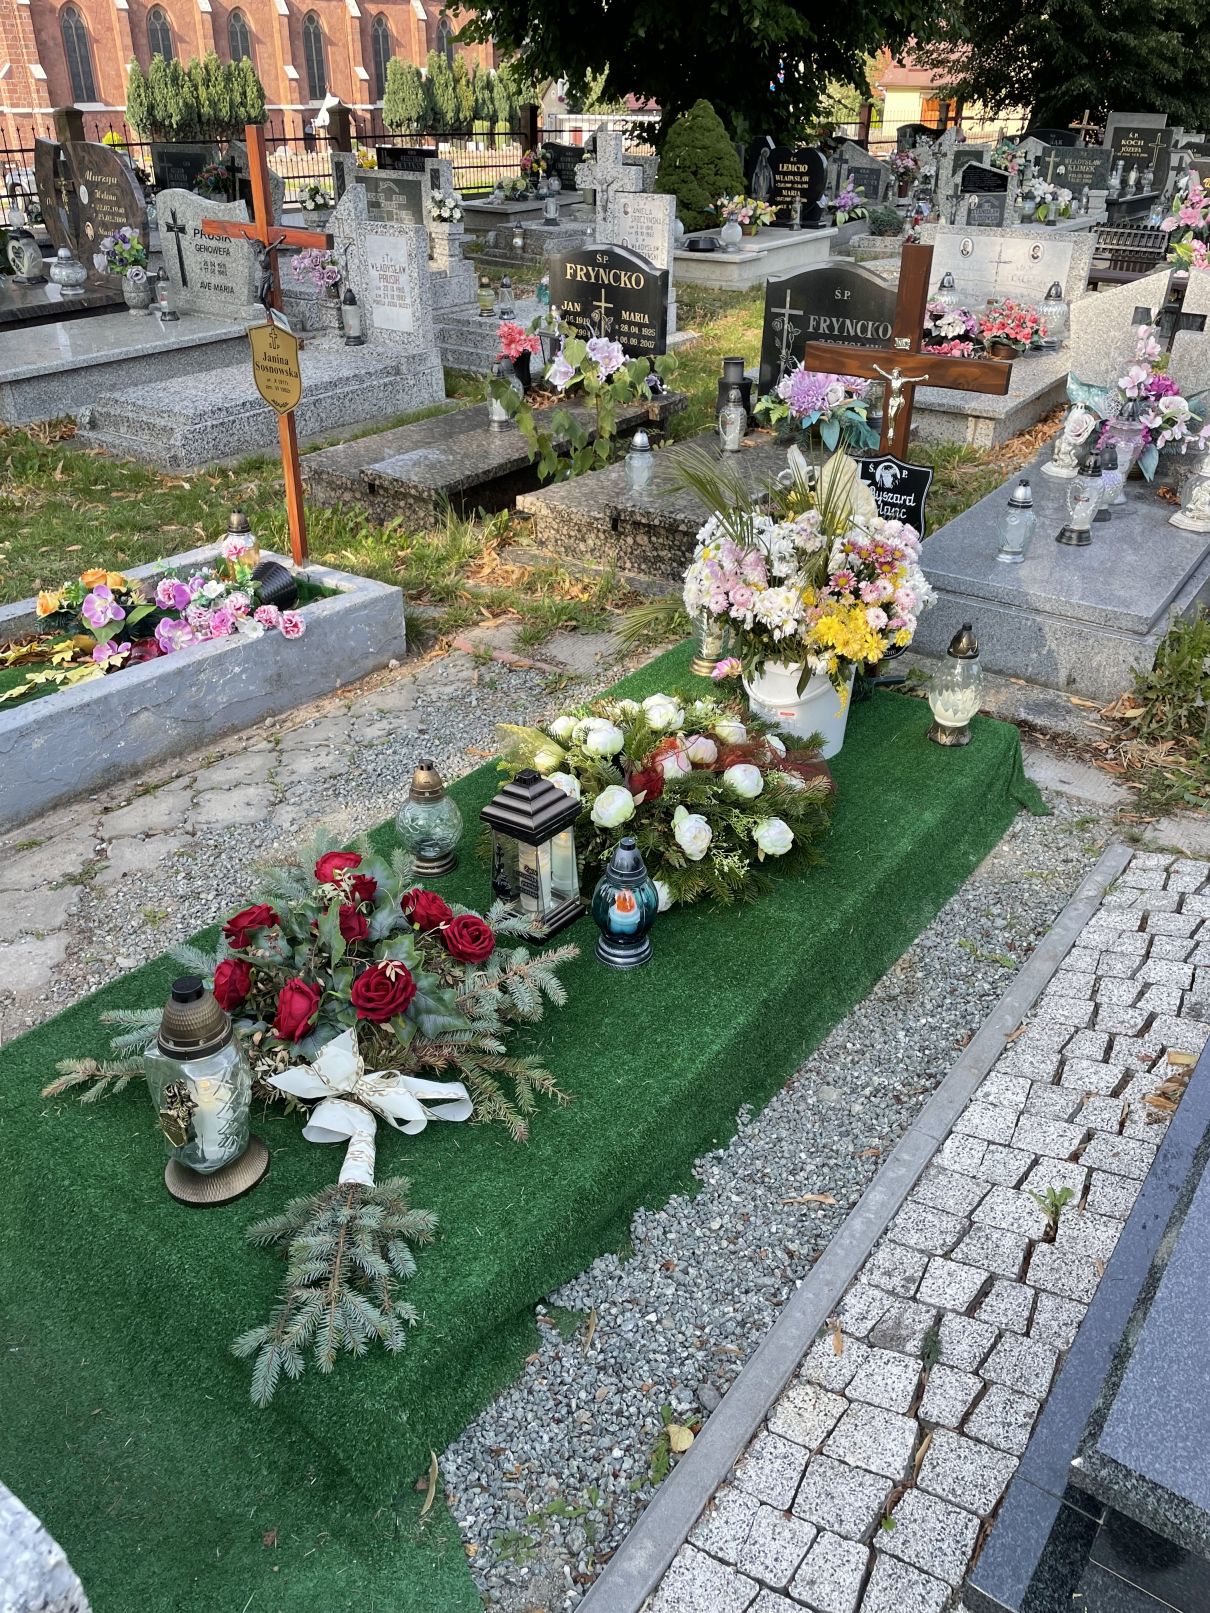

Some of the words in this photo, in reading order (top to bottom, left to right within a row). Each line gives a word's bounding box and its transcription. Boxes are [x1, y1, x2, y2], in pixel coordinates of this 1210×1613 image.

[194, 243, 231, 256] GENOWEFA
[565, 262, 645, 290] FRYNCKO
[200, 281, 212, 291] AVE
[213, 283, 235, 295] MARIA
[561, 300, 581, 312] JAN
[621, 310, 649, 324] MARIA
[807, 315, 892, 340] FRYNCKO
[262, 351, 289, 366] Janina
[255, 360, 299, 379] Sosnowska
[869, 485, 916, 507] Ryszard
